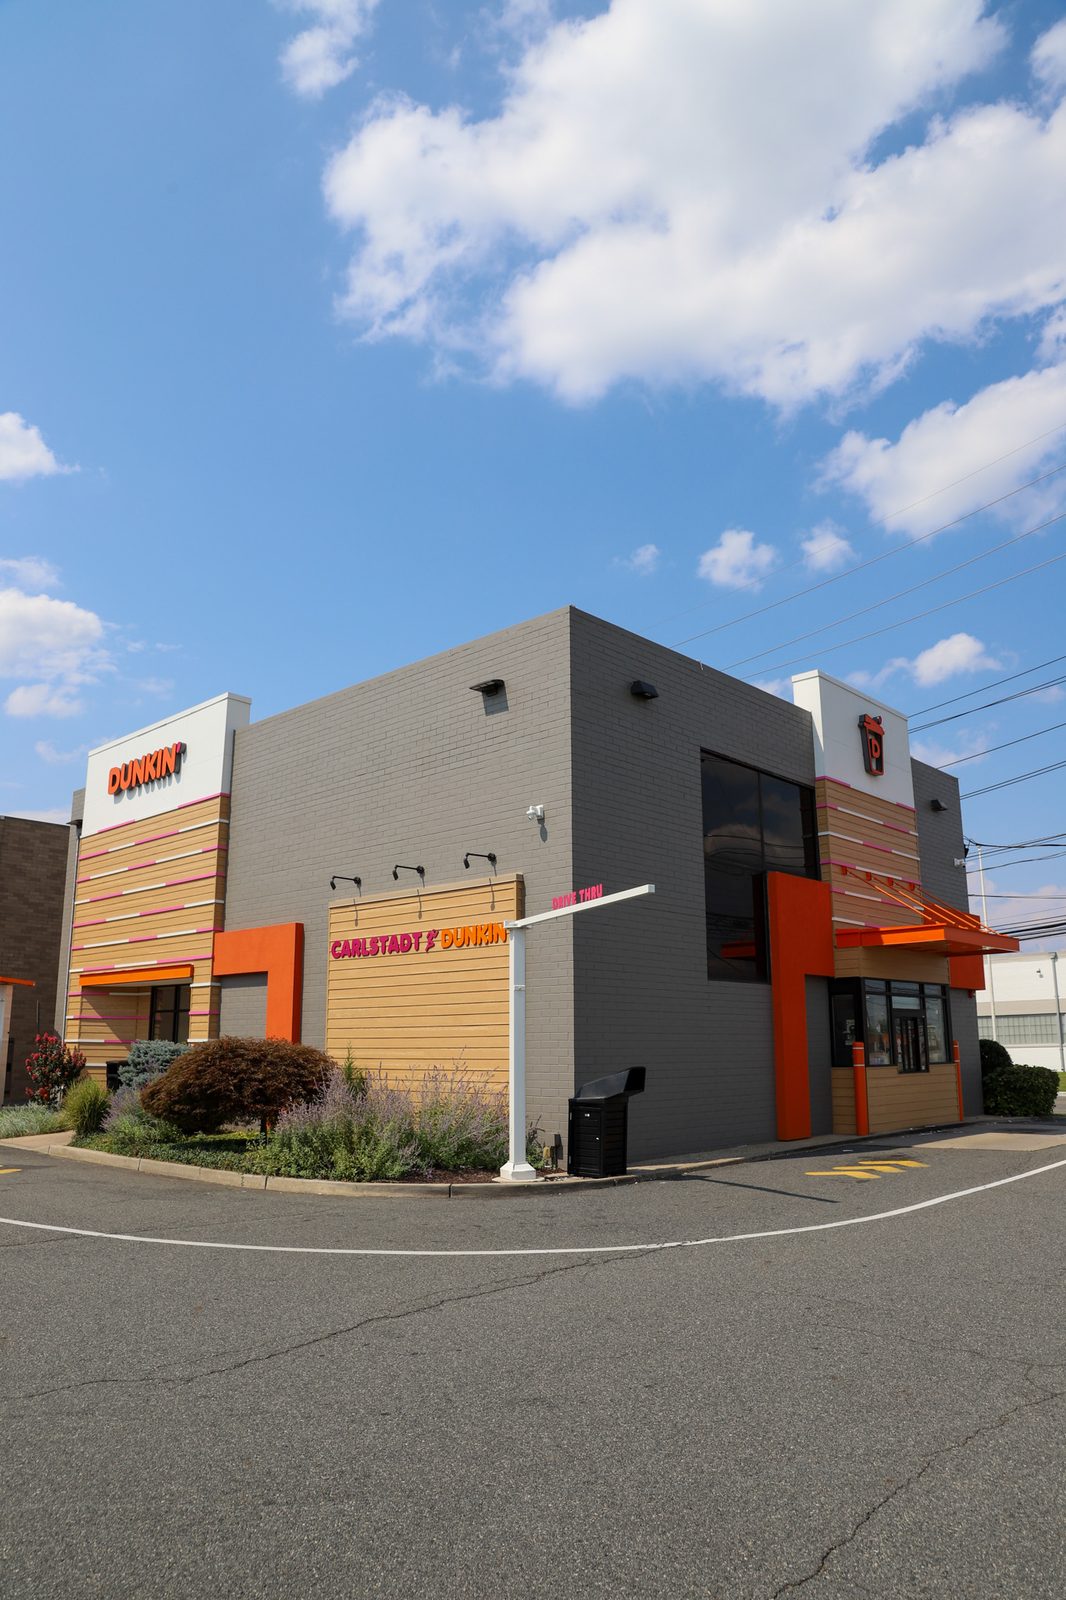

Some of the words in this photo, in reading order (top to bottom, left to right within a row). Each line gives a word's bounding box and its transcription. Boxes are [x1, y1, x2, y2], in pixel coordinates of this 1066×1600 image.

[551, 891, 577, 910] DRIVE
[579, 883, 603, 903] THRU
[331, 931, 422, 959] CARLSTADT
